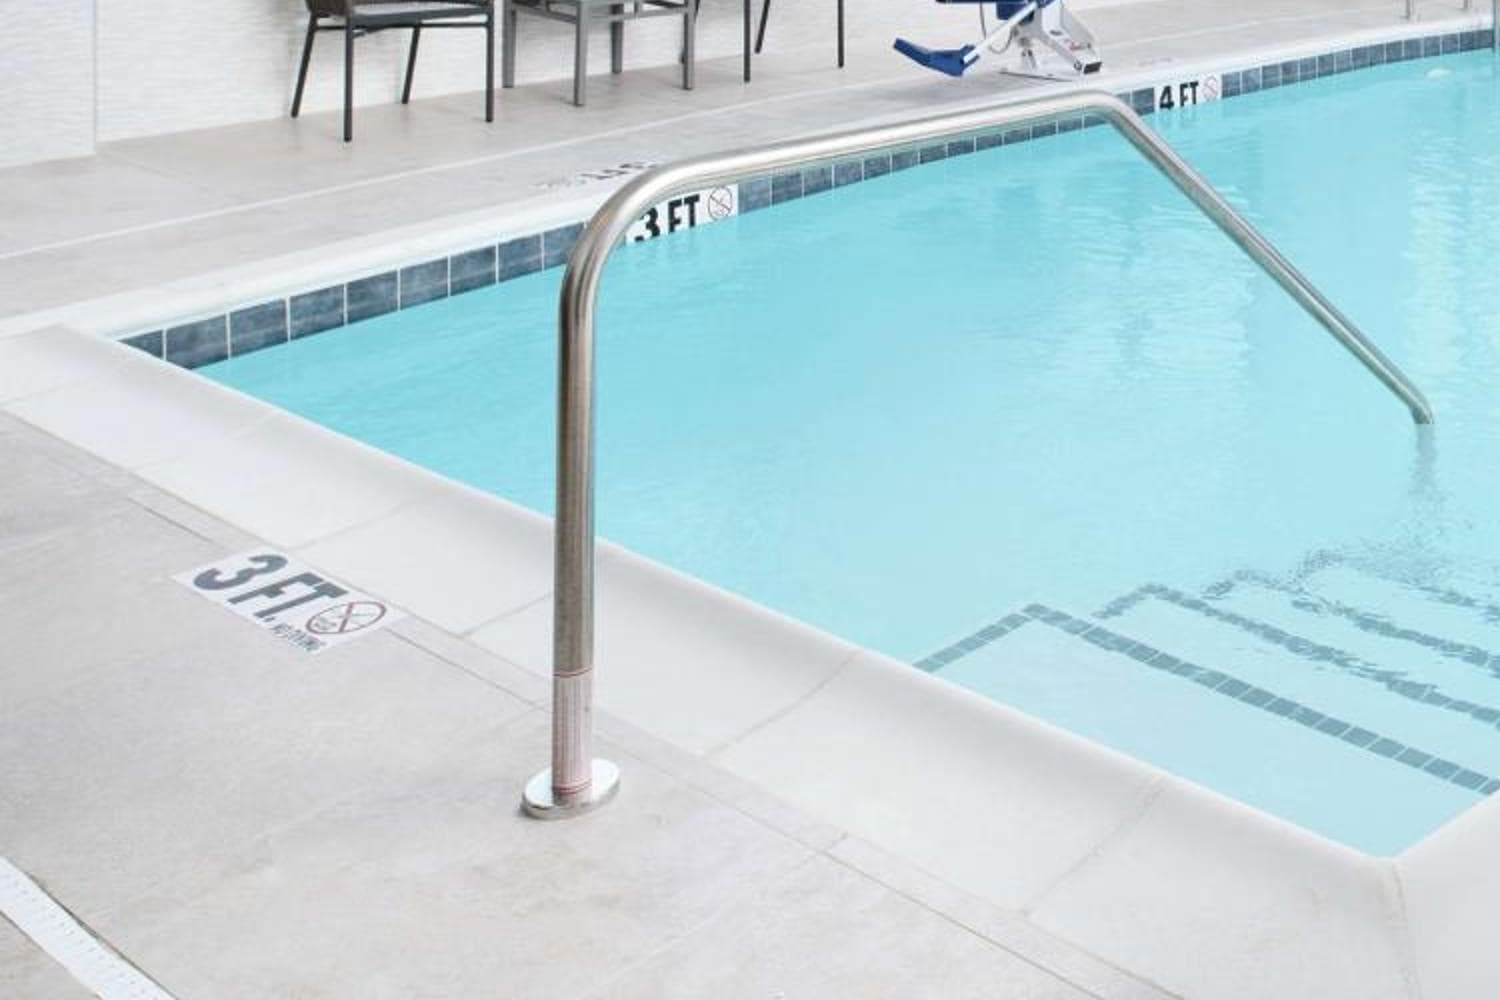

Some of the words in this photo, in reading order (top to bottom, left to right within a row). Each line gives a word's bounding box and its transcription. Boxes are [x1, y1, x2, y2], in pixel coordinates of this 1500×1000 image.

[1160, 86, 1175, 109] 4
[1180, 81, 1199, 107] FT
[635, 207, 660, 242] 3
[668, 194, 700, 234] FT
[193, 554, 288, 590] 3
